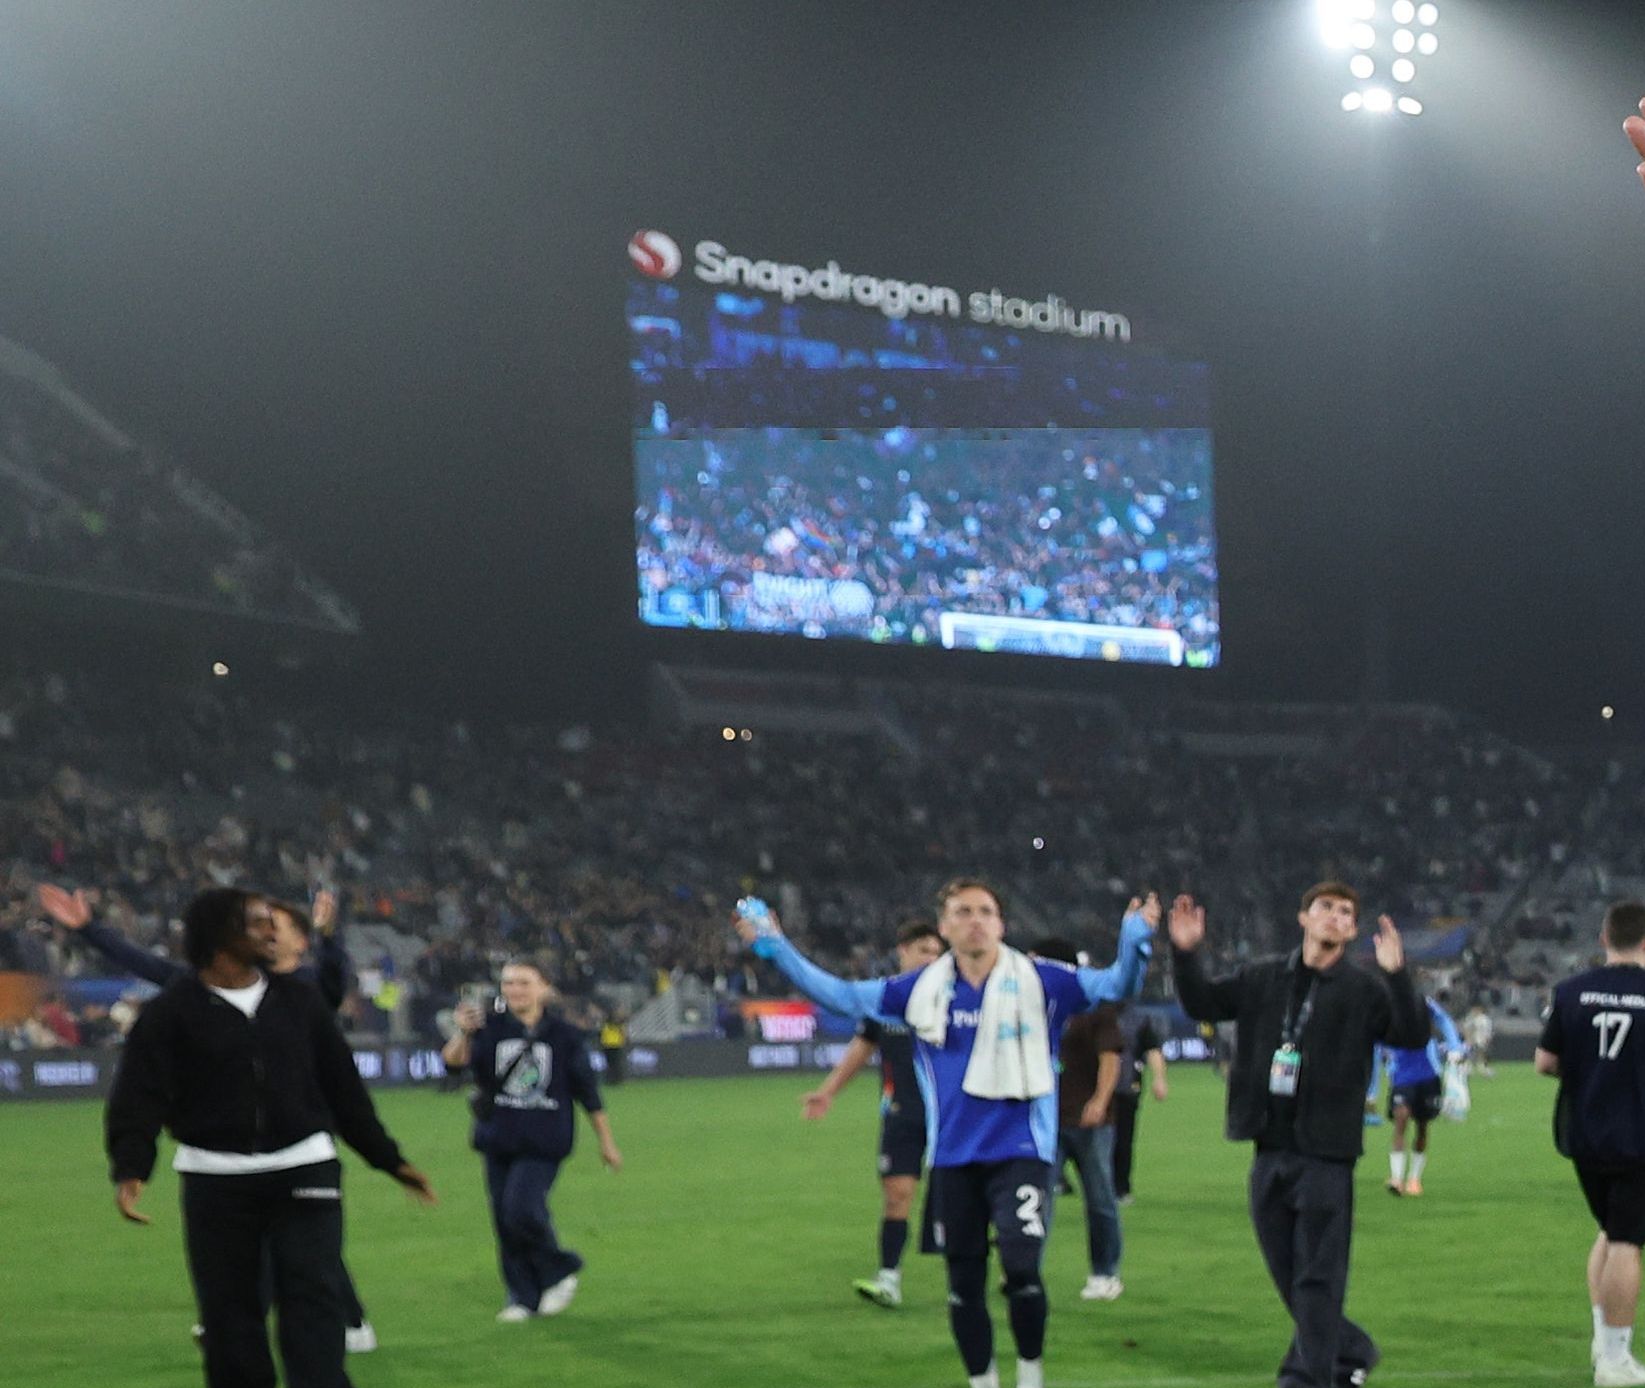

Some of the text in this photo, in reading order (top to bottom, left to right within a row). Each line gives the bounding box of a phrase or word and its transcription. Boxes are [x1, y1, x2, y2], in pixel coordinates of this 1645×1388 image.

[695, 240, 1132, 342] Snapdragon stadium
[1591, 1011, 1634, 1060] 17
